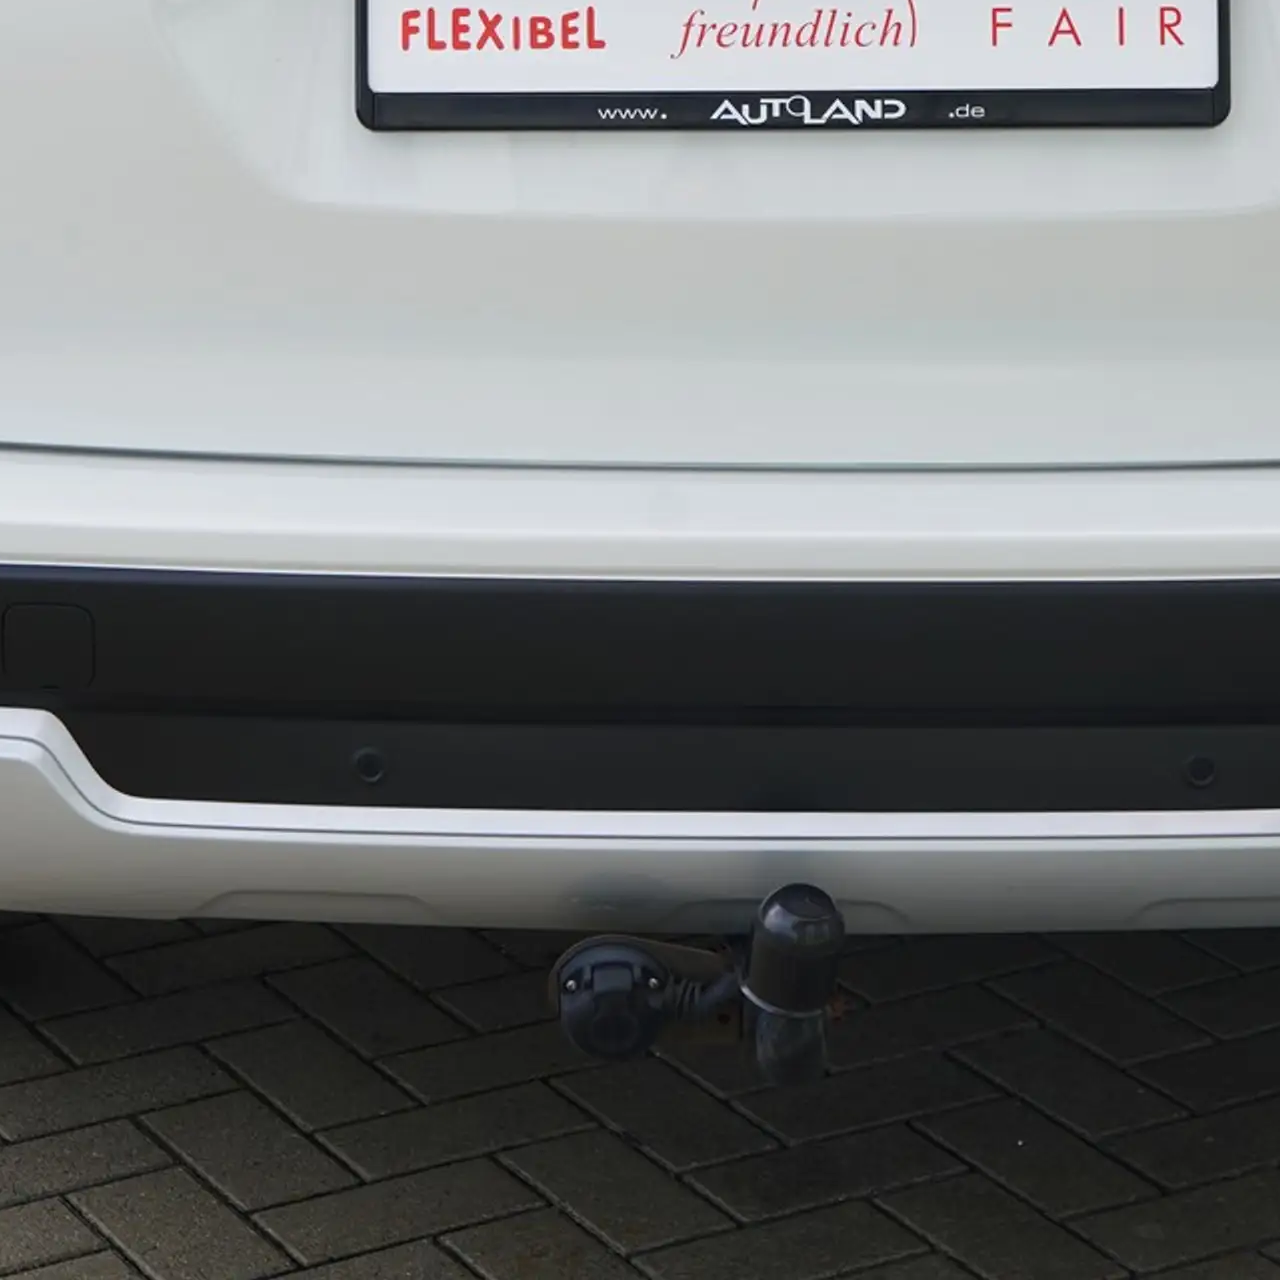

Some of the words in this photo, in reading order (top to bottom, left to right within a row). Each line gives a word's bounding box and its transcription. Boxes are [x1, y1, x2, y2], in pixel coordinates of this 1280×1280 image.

[401, 5, 607, 51] FLEXIBEL
[669, 8, 904, 60] freundlich
[991, 5, 1185, 47] FAIR
[597, 107, 668, 120] www.
[709, 94, 908, 125] AUTOLAND
[948, 103, 986, 119] .de
